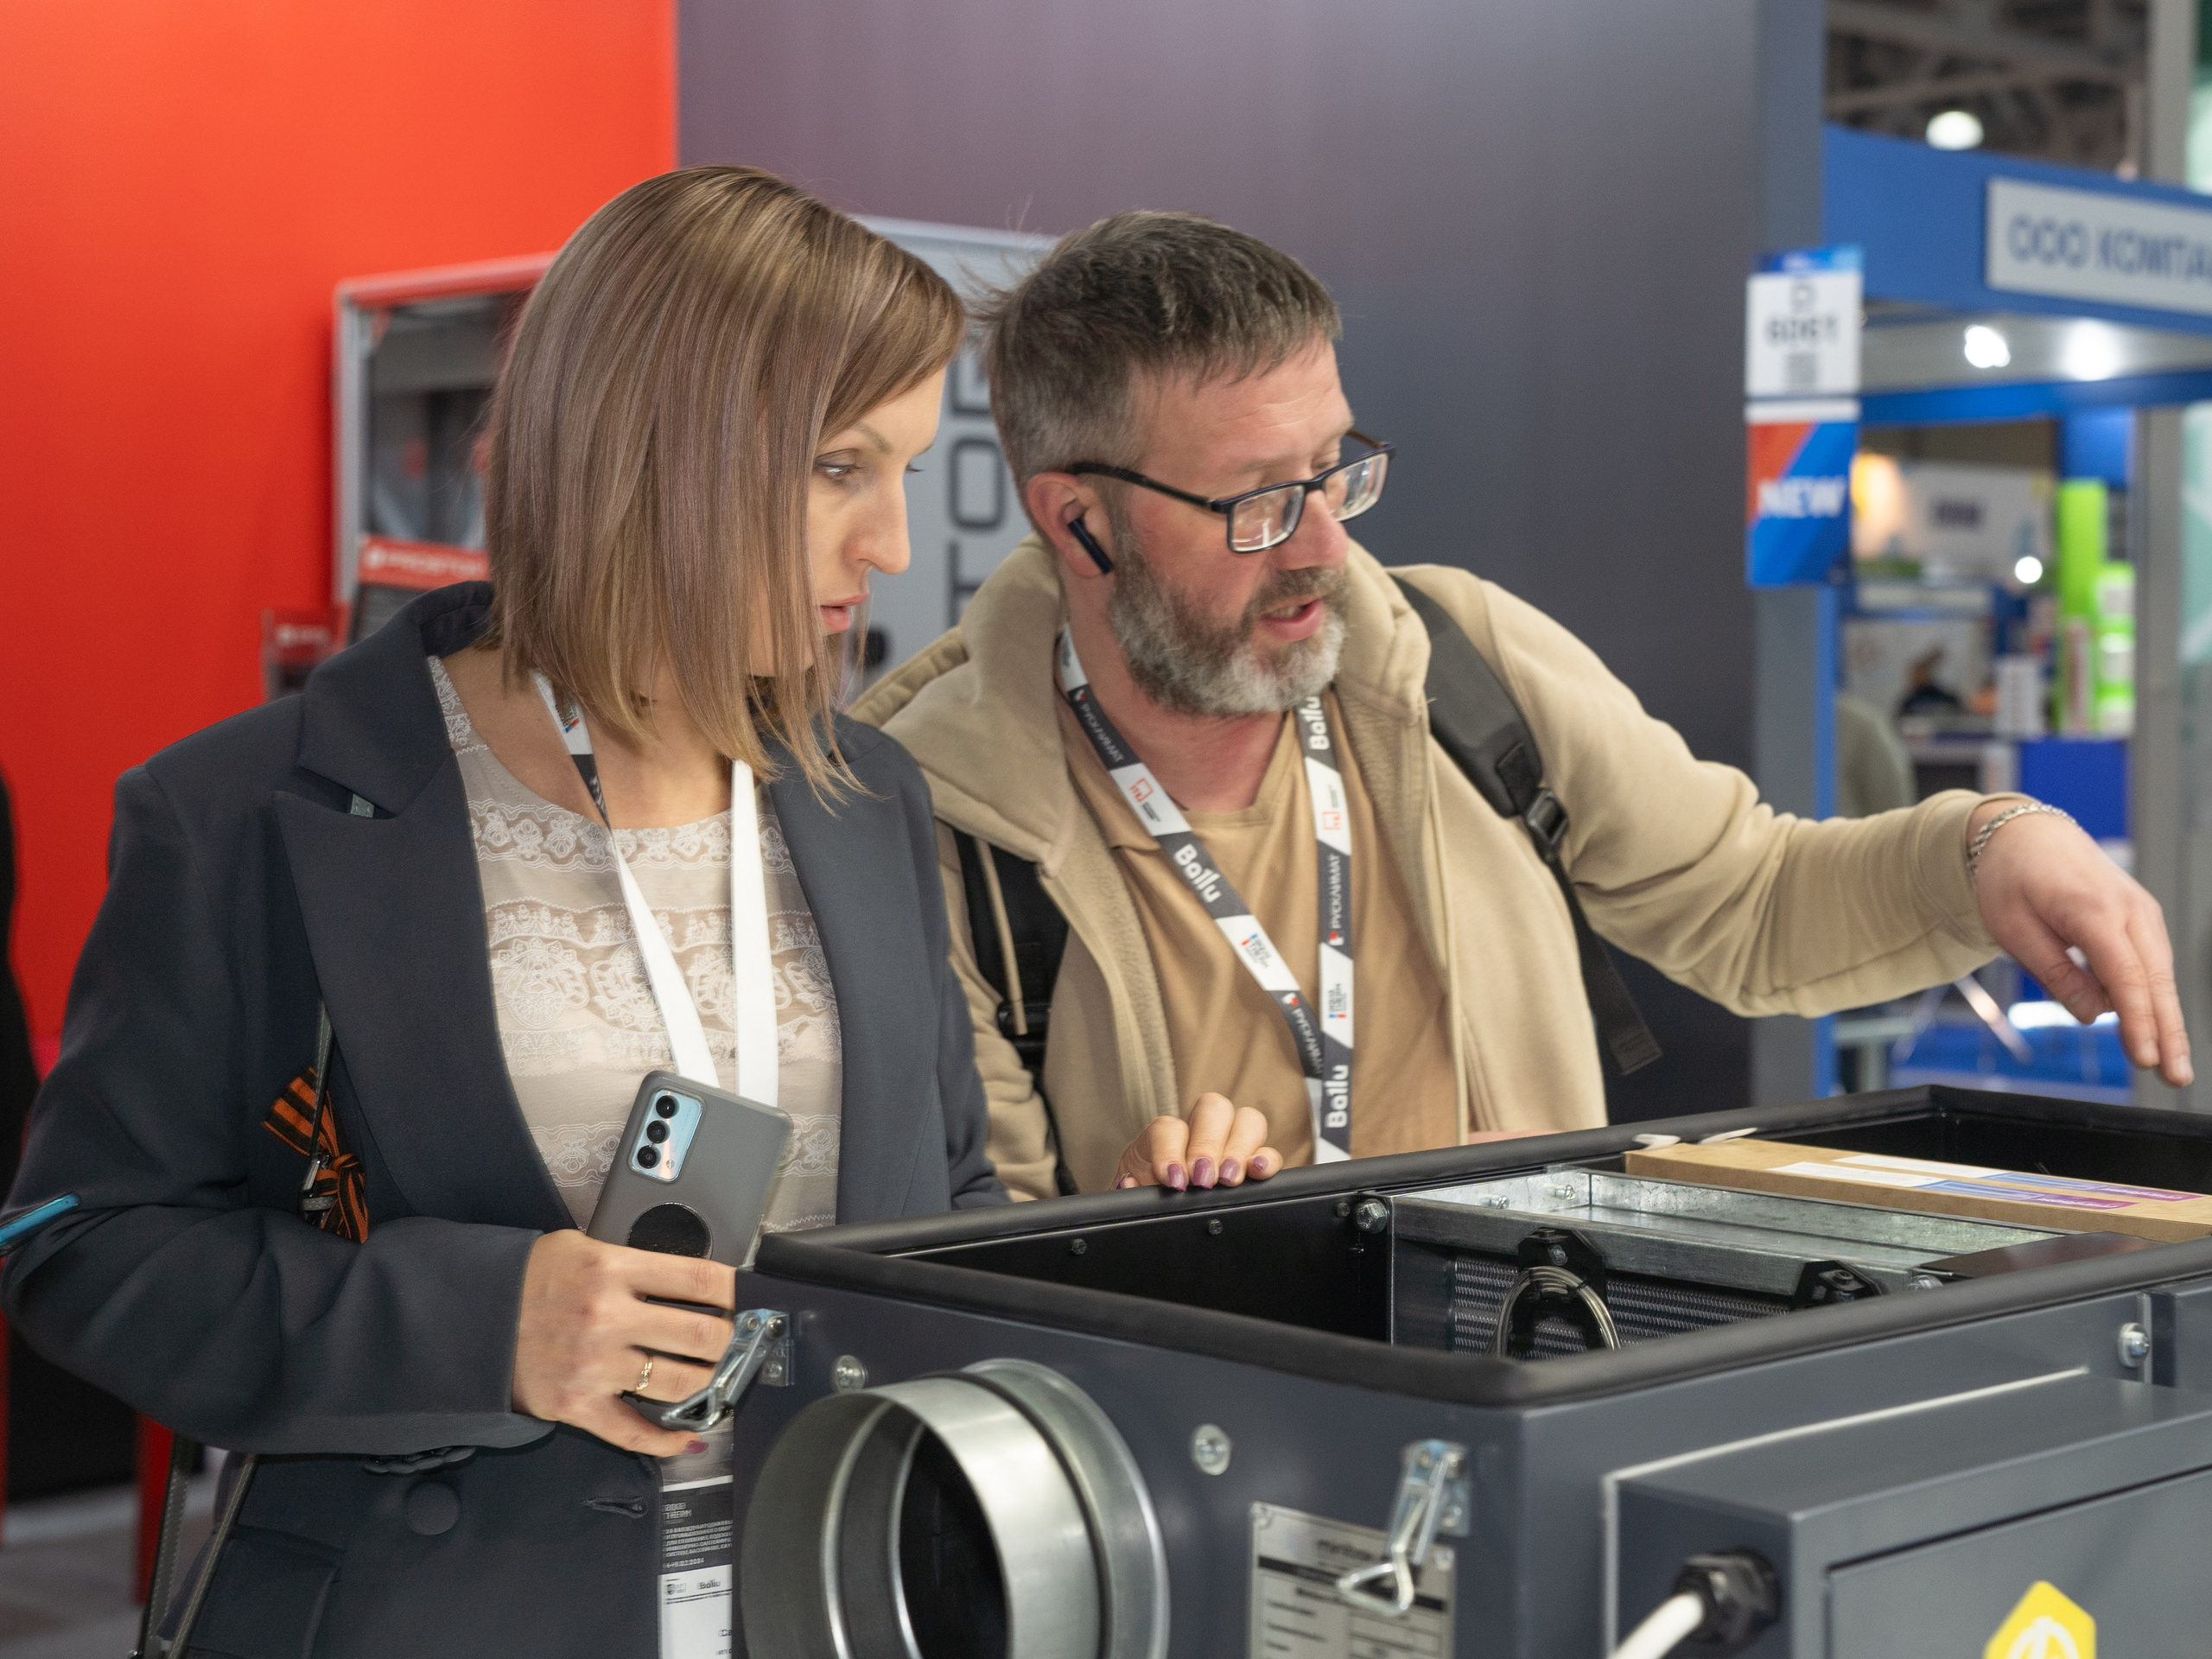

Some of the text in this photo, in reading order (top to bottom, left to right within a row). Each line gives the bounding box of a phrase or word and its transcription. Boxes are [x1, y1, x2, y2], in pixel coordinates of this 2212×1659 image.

[1758, 477, 1845, 518] NEW
[1300, 696, 1331, 750] Ballu
[1174, 843, 1221, 903] Ballu
[1324, 1065, 1349, 1128] Ballu
